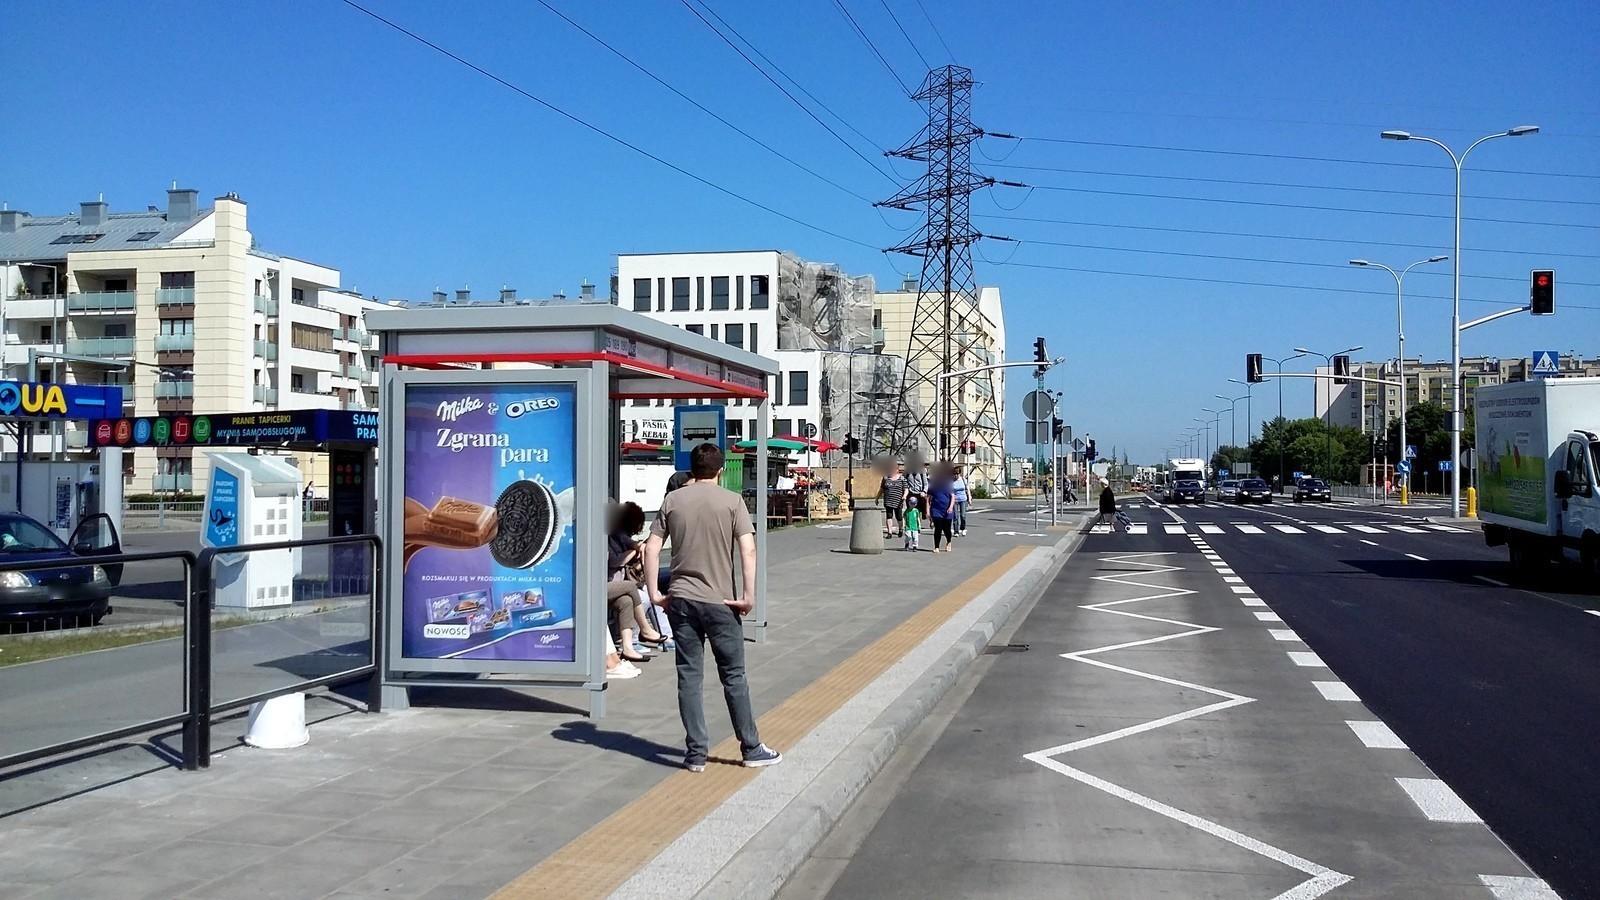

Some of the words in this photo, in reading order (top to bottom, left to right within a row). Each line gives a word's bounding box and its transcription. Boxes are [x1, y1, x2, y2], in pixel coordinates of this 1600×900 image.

[437, 396, 484, 422] Milka
[487, 402, 499, 415] &
[505, 397, 560, 418] OREO
[232, 416, 256, 425] PRANIE
[259, 415, 291, 424] TAPICERKI
[642, 421, 668, 429] PASHA
[242, 427, 306, 437] SAMOOBSŁUGOWA
[357, 428, 379, 439] PRA
[642, 431, 668, 439] KEBAB
[437, 428, 510, 453] Zgrana
[500, 446, 549, 467] para
